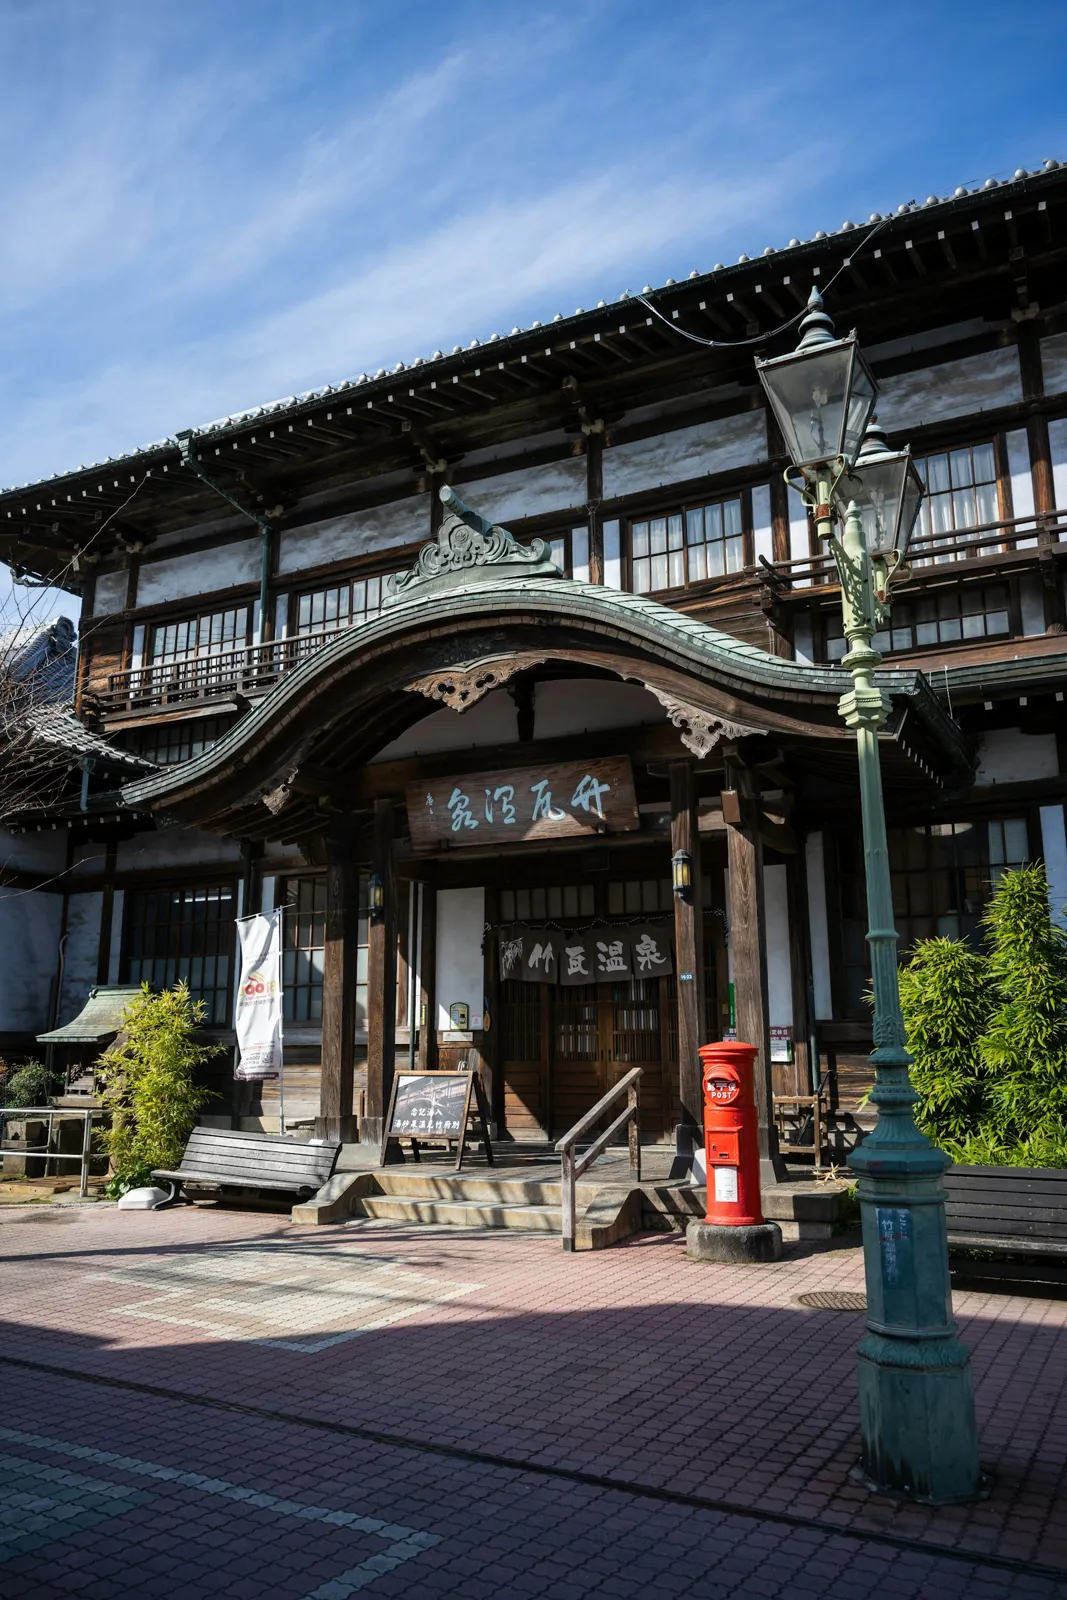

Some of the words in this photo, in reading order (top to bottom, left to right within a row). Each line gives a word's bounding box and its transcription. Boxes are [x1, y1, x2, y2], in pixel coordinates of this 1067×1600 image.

[528, 934, 667, 975] 竹瓦温泉
[711, 1091, 732, 1099] POST
